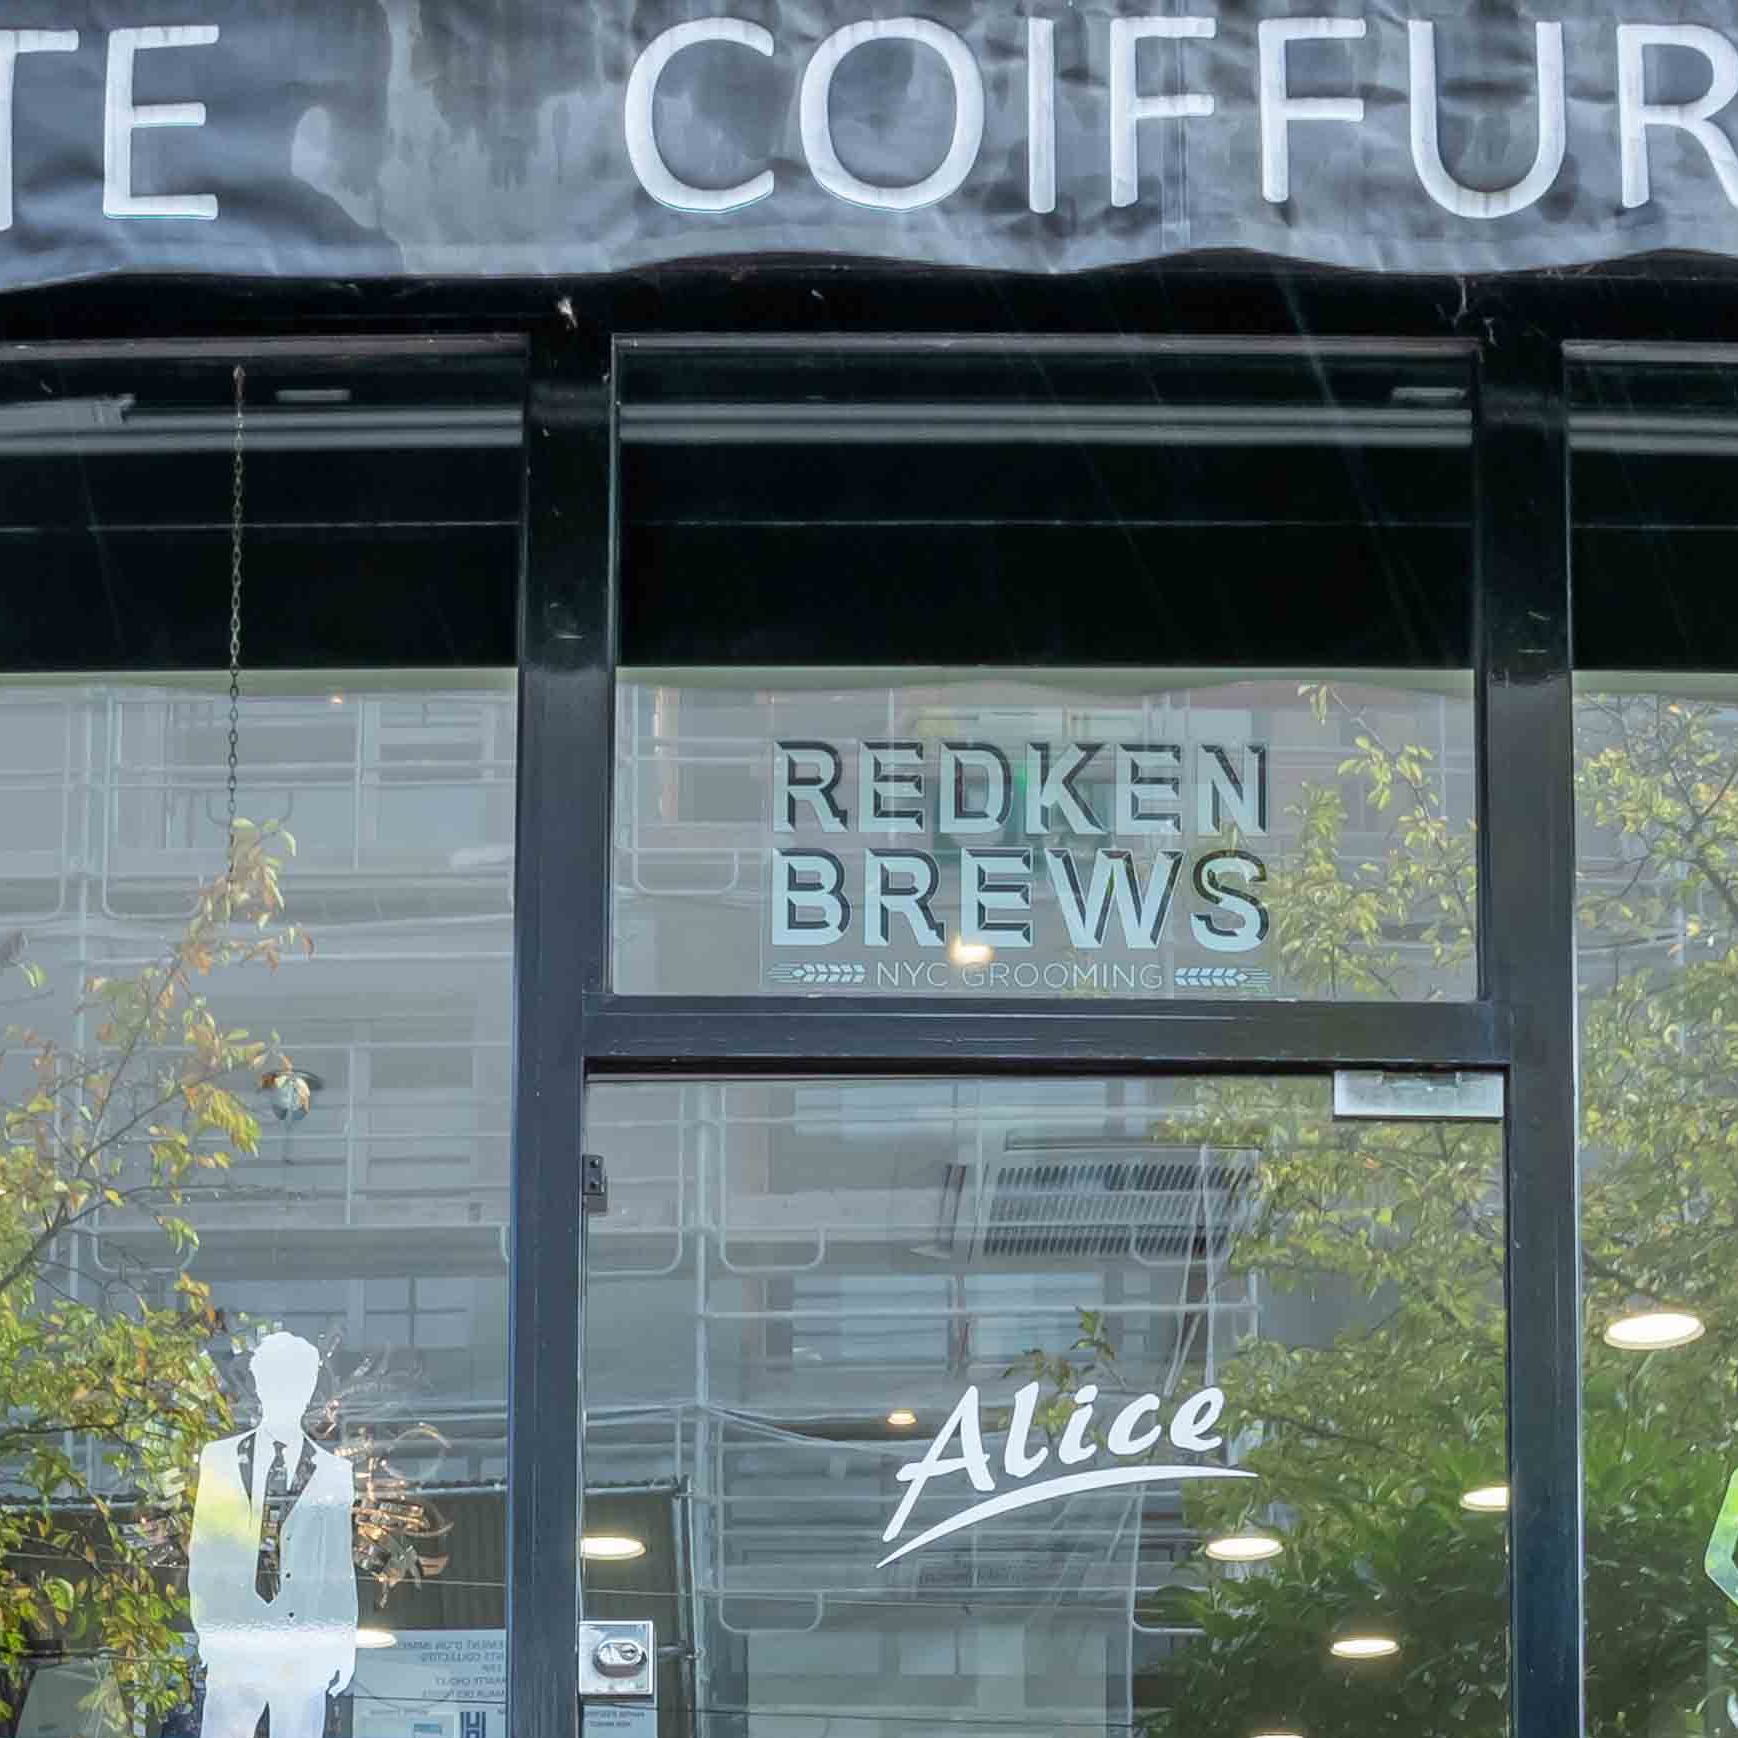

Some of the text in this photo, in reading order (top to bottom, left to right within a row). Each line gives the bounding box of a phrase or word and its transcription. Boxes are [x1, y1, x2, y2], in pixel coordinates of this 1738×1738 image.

[772, 739, 1268, 836] REDKEN
[772, 847, 1270, 952] BREWS
[876, 960, 1163, 990] NYC GROOMING
[881, 1381, 1225, 1542] Alice
